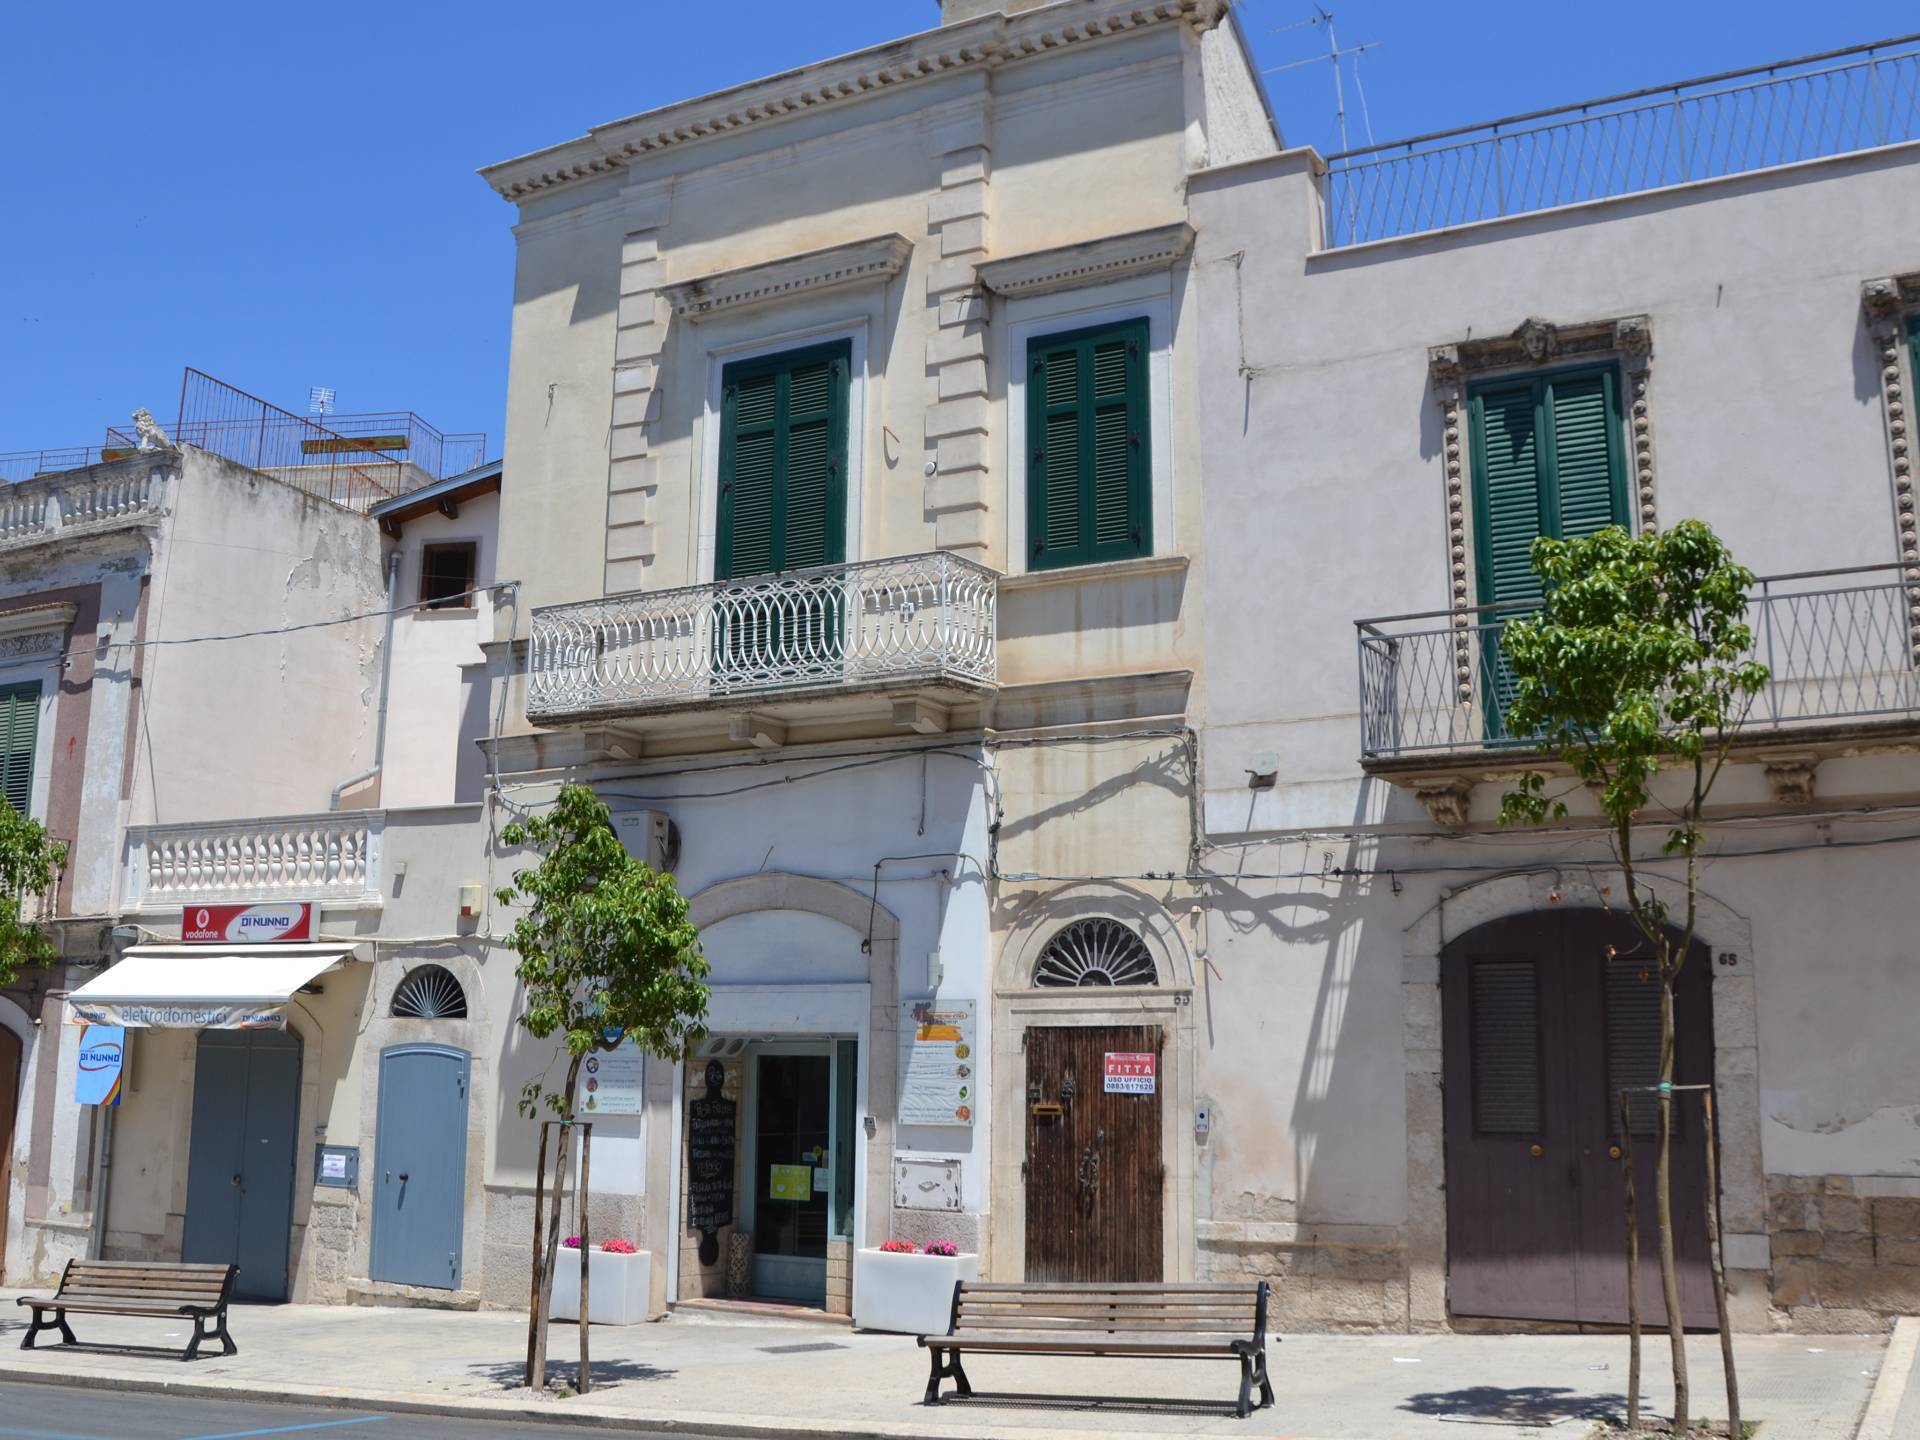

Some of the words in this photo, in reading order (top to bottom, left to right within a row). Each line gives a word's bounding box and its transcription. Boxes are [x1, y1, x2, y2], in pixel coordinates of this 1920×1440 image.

[241, 917, 251, 927] DI
[253, 917, 289, 927] NUNNO
[186, 930, 219, 939] vodafone
[1719, 953, 1737, 966] 65
[121, 1006, 227, 1025] elettrodomestici
[80, 1053, 88, 1061] DI
[90, 1053, 120, 1062] NUNNO
[1108, 1064, 1152, 1074] FITTA
